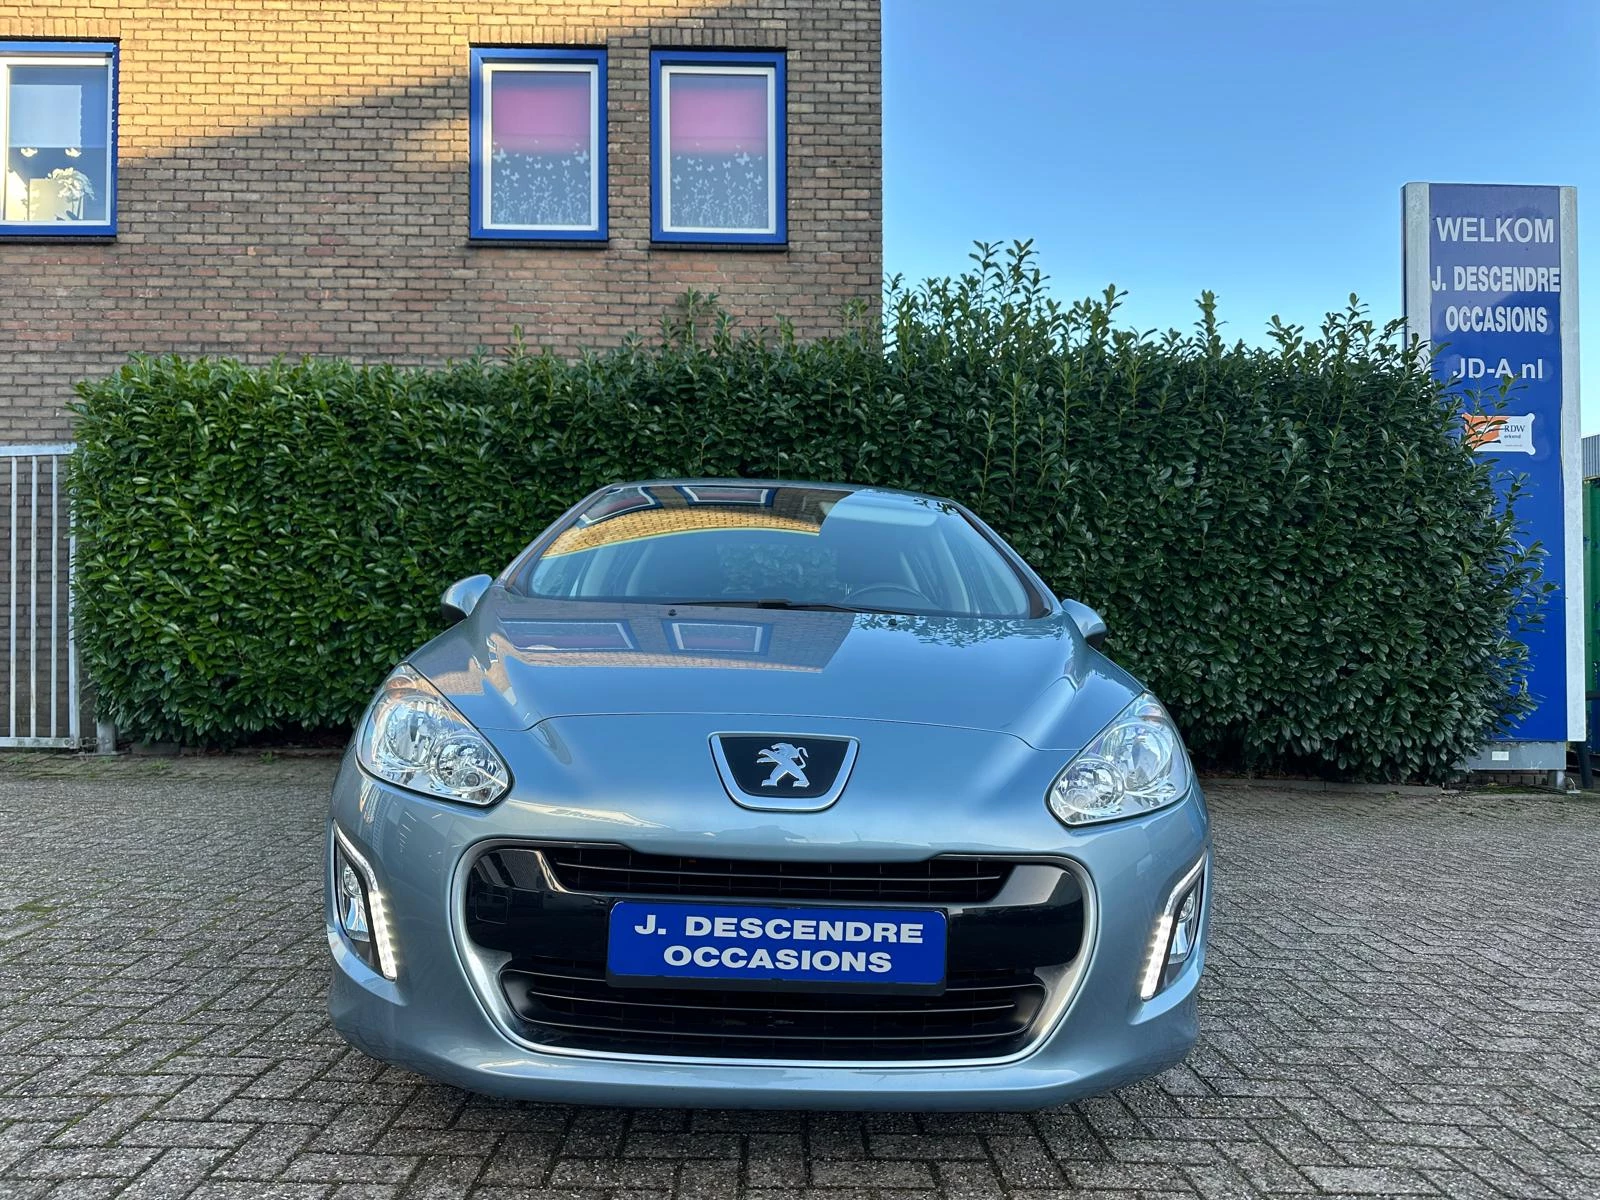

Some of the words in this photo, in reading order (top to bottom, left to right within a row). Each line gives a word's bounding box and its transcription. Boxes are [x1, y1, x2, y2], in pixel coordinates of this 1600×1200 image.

[1436, 217, 1554, 243] WELKOM
[1432, 265, 1447, 292] J.
[1453, 265, 1560, 292] DESCENDRE
[1445, 305, 1548, 333] OCCASIONS
[1452, 357, 1543, 379] JD-Anl
[1504, 424, 1526, 433] RDW
[634, 914, 668, 935] J.
[685, 916, 924, 944] DESCENDRE
[663, 945, 893, 973] OCCASIONS
